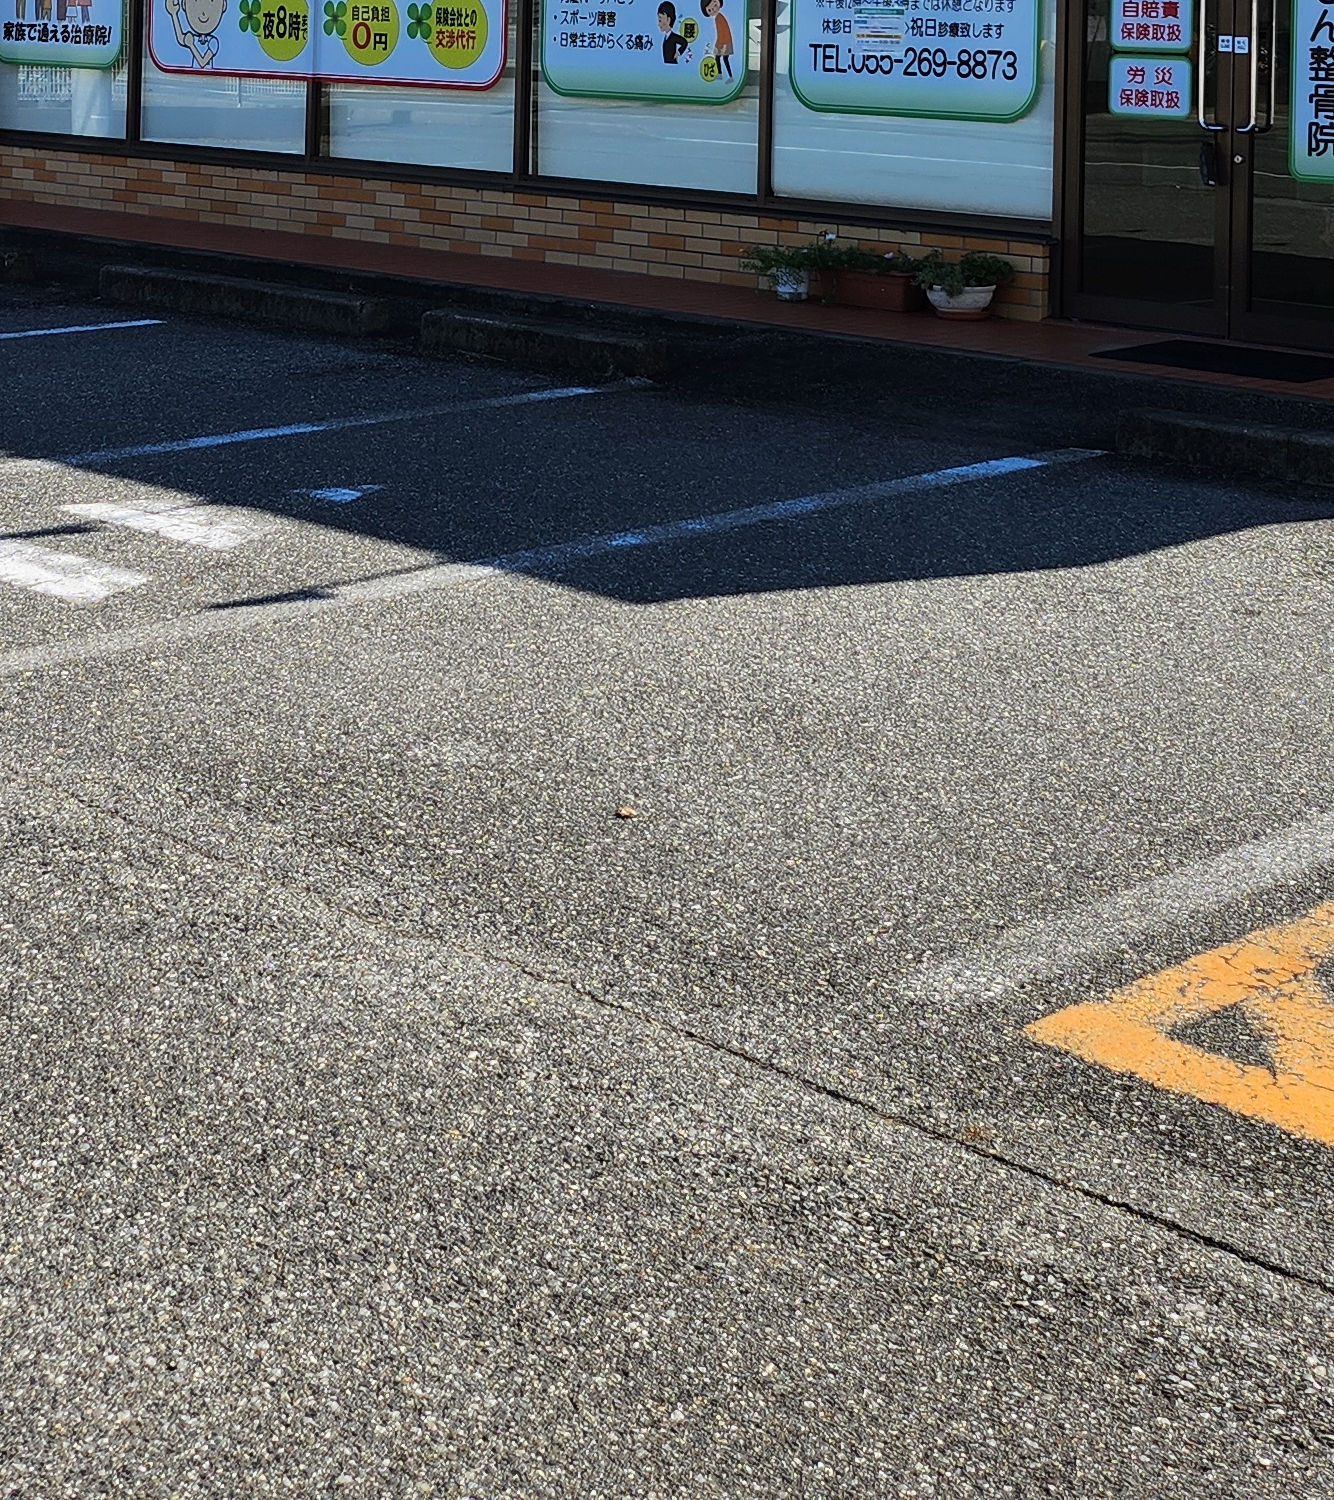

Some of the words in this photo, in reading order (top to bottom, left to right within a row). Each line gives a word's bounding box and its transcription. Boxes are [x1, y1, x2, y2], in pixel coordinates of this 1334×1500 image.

[351, 5, 391, 23] 自己負担
[435, 6, 477, 27] 保険会社との
[1122, 0, 1180, 20] 自賠責
[352, 21, 388, 51] 0円
[435, 29, 476, 50] 交渉代行
[1120, 22, 1182, 43] 保険取扱
[1119, 88, 1181, 110] 保険取扱
